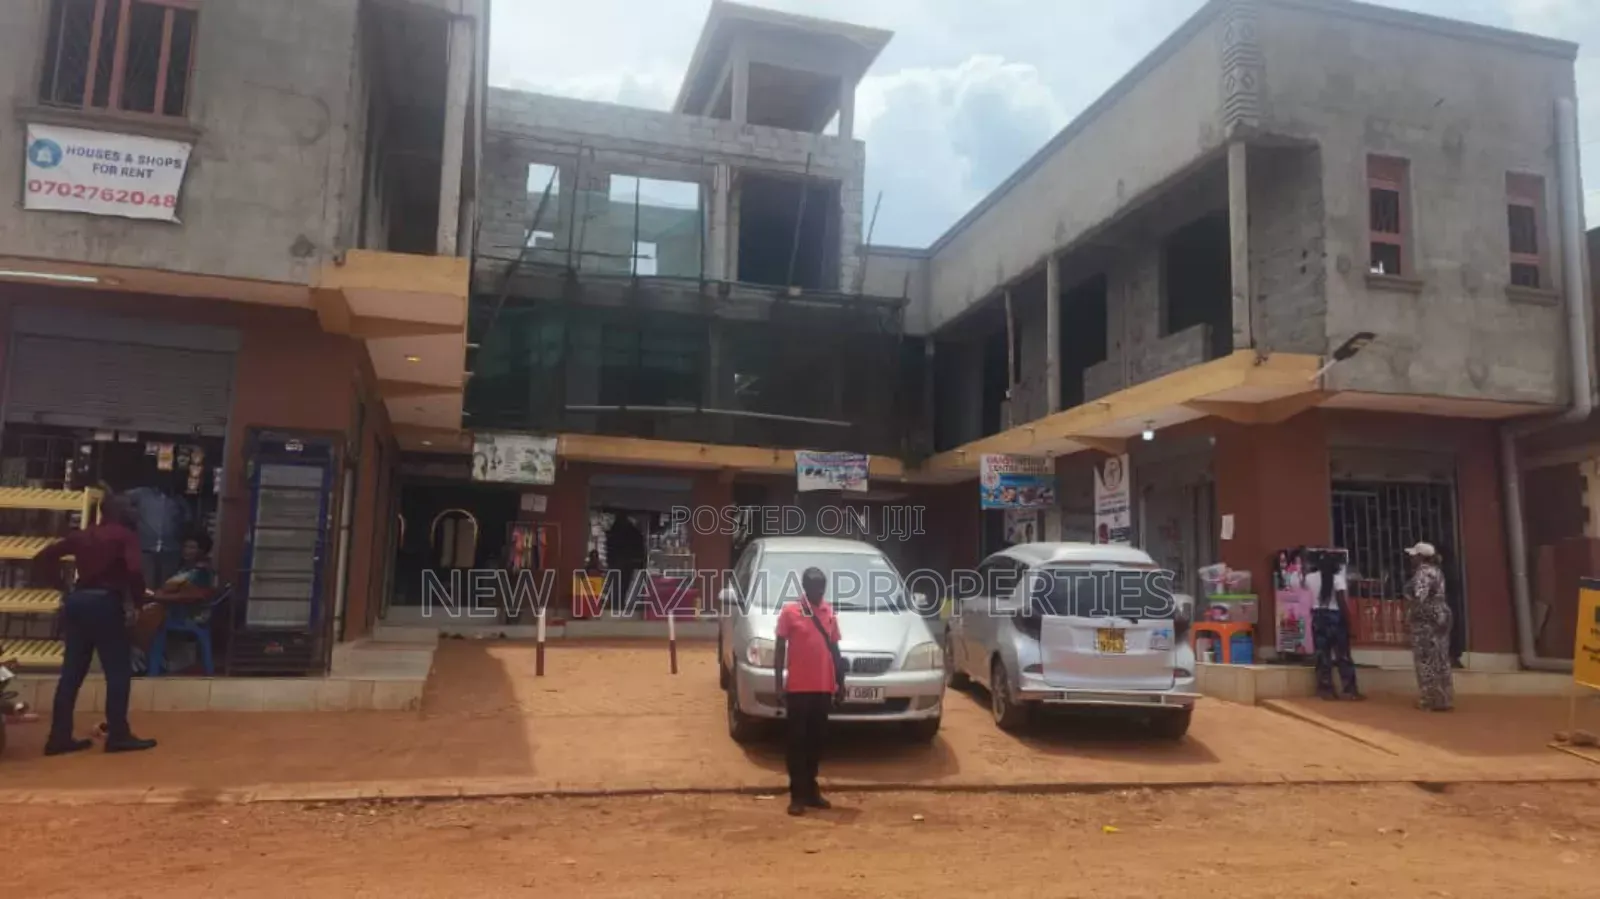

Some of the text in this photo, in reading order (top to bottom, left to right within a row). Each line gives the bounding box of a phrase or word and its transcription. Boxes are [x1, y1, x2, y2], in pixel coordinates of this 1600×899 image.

[66, 145, 183, 169] HOUSES & SHOPS
[92, 163, 154, 179] FOR RENT
[28, 179, 177, 208] 0702762048
